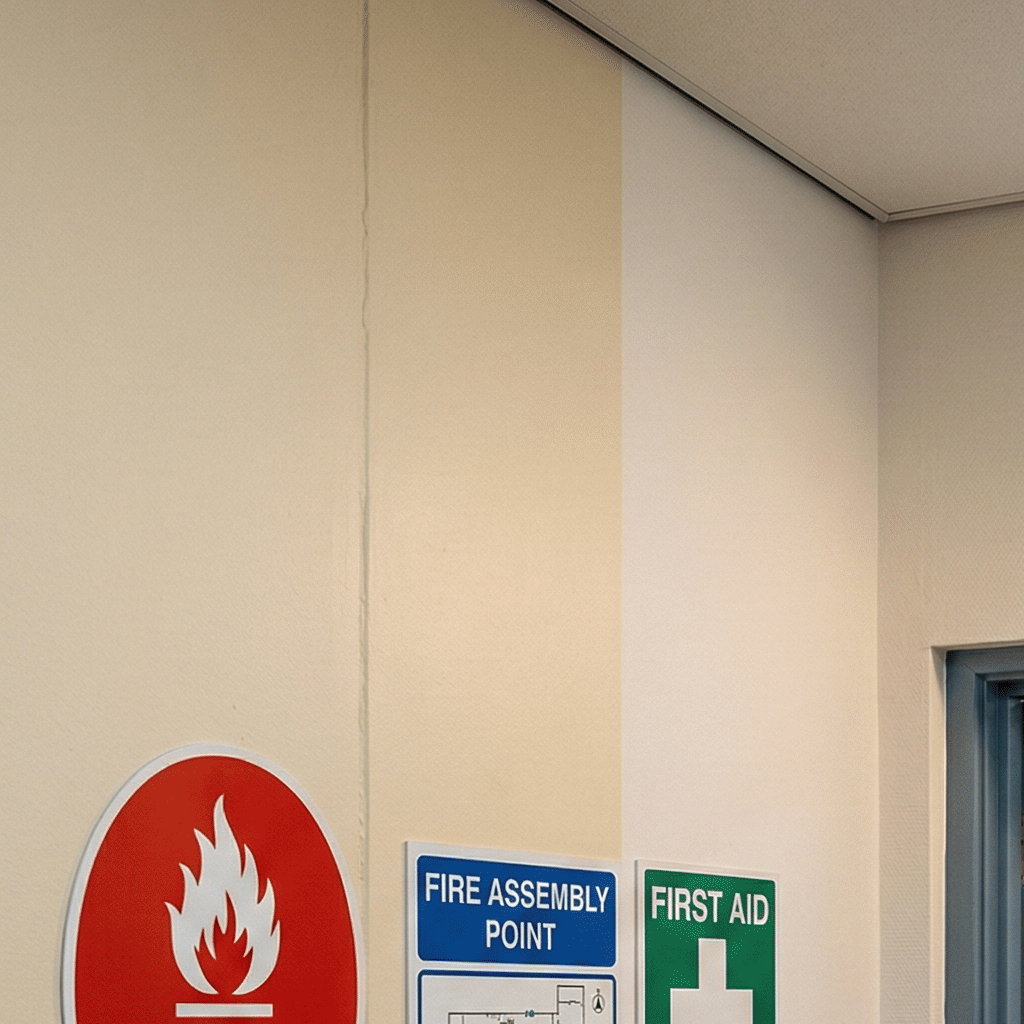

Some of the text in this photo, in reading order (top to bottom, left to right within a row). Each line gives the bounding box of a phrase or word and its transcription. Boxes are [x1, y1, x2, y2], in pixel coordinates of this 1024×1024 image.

[425, 872, 609, 913] FIRE ASSEMBLY
[651, 885, 769, 925] FIRST AID
[485, 919, 556, 950] POINT
